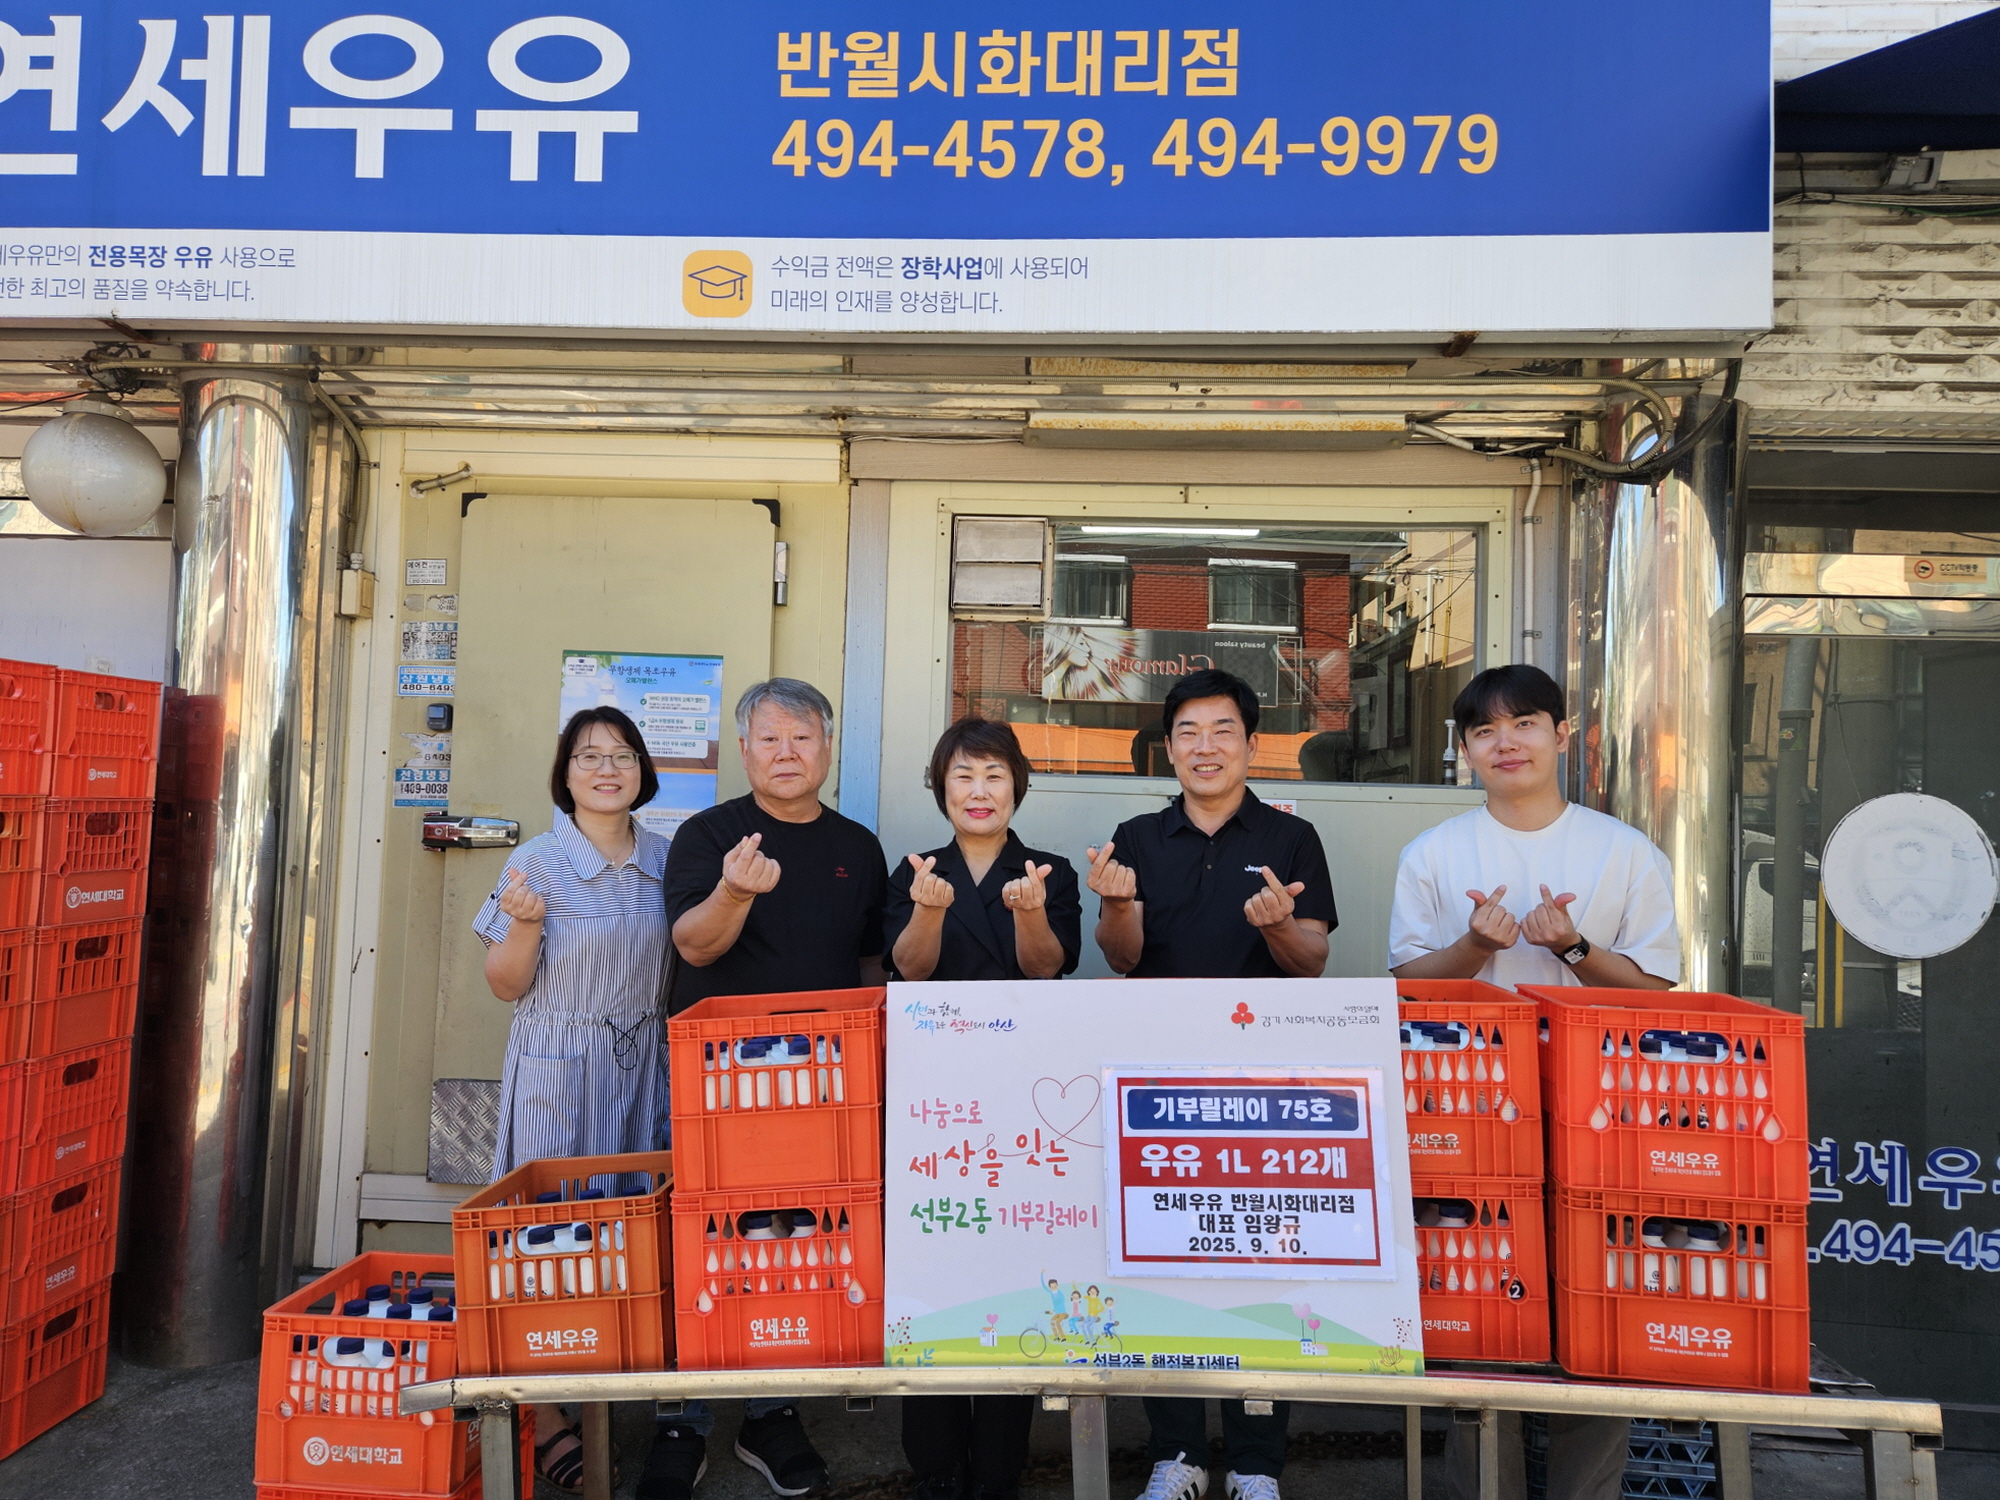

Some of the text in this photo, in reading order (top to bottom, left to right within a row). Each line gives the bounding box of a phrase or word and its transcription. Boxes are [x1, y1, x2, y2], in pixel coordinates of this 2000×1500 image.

[776, 28, 1241, 99] 반월시화대리점
[0, 14, 640, 183] 연세우유
[772, 114, 1499, 187] 494-4578, 494-9979
[88, 245, 167, 269] 전용목장
[173, 246, 213, 269] 우유
[219, 246, 296, 269] 사용으로
[770, 255, 1089, 281] 수익금 전액은 장학사업에 사용되어
[30, 277, 86, 300] 최고의
[92, 278, 149, 301] 품질을
[155, 278, 255, 302] 약속합니다.
[770, 289, 1004, 315] 미래의 인재를 양성합니다.
[81, 888, 124, 904] 연세대학교
[988, 1018, 1017, 1032] 안산
[1260, 1014, 1281, 1028] 경기
[909, 1096, 984, 1130] 나눔으로
[1153, 1096, 1333, 1123] 기부릴레이 75호
[1408, 1133, 1460, 1148] 세우유
[908, 1127, 1070, 1188] 세상을 잇는
[1140, 1143, 1348, 1179] 우유 1L 212개
[1649, 1150, 1719, 1169] 연세우유
[1807, 1136, 2000, 1210] 연세우
[909, 1195, 1099, 1235] 선부2동 기부릴레이
[1153, 1192, 1355, 1214] 연세우유 반월시화대리점
[1198, 1213, 1301, 1235] 대표 임왕규
[1188, 1236, 1307, 1255] 2025. 9. 10.
[45, 1265, 75, 1288] 연세우유
[750, 1316, 809, 1340] 연세우유
[1423, 1319, 1471, 1332] 연세대학교
[1645, 1322, 1732, 1350] 연세우유
[525, 1327, 599, 1351] 연세우유
[329, 1444, 403, 1465] 연세대학교
